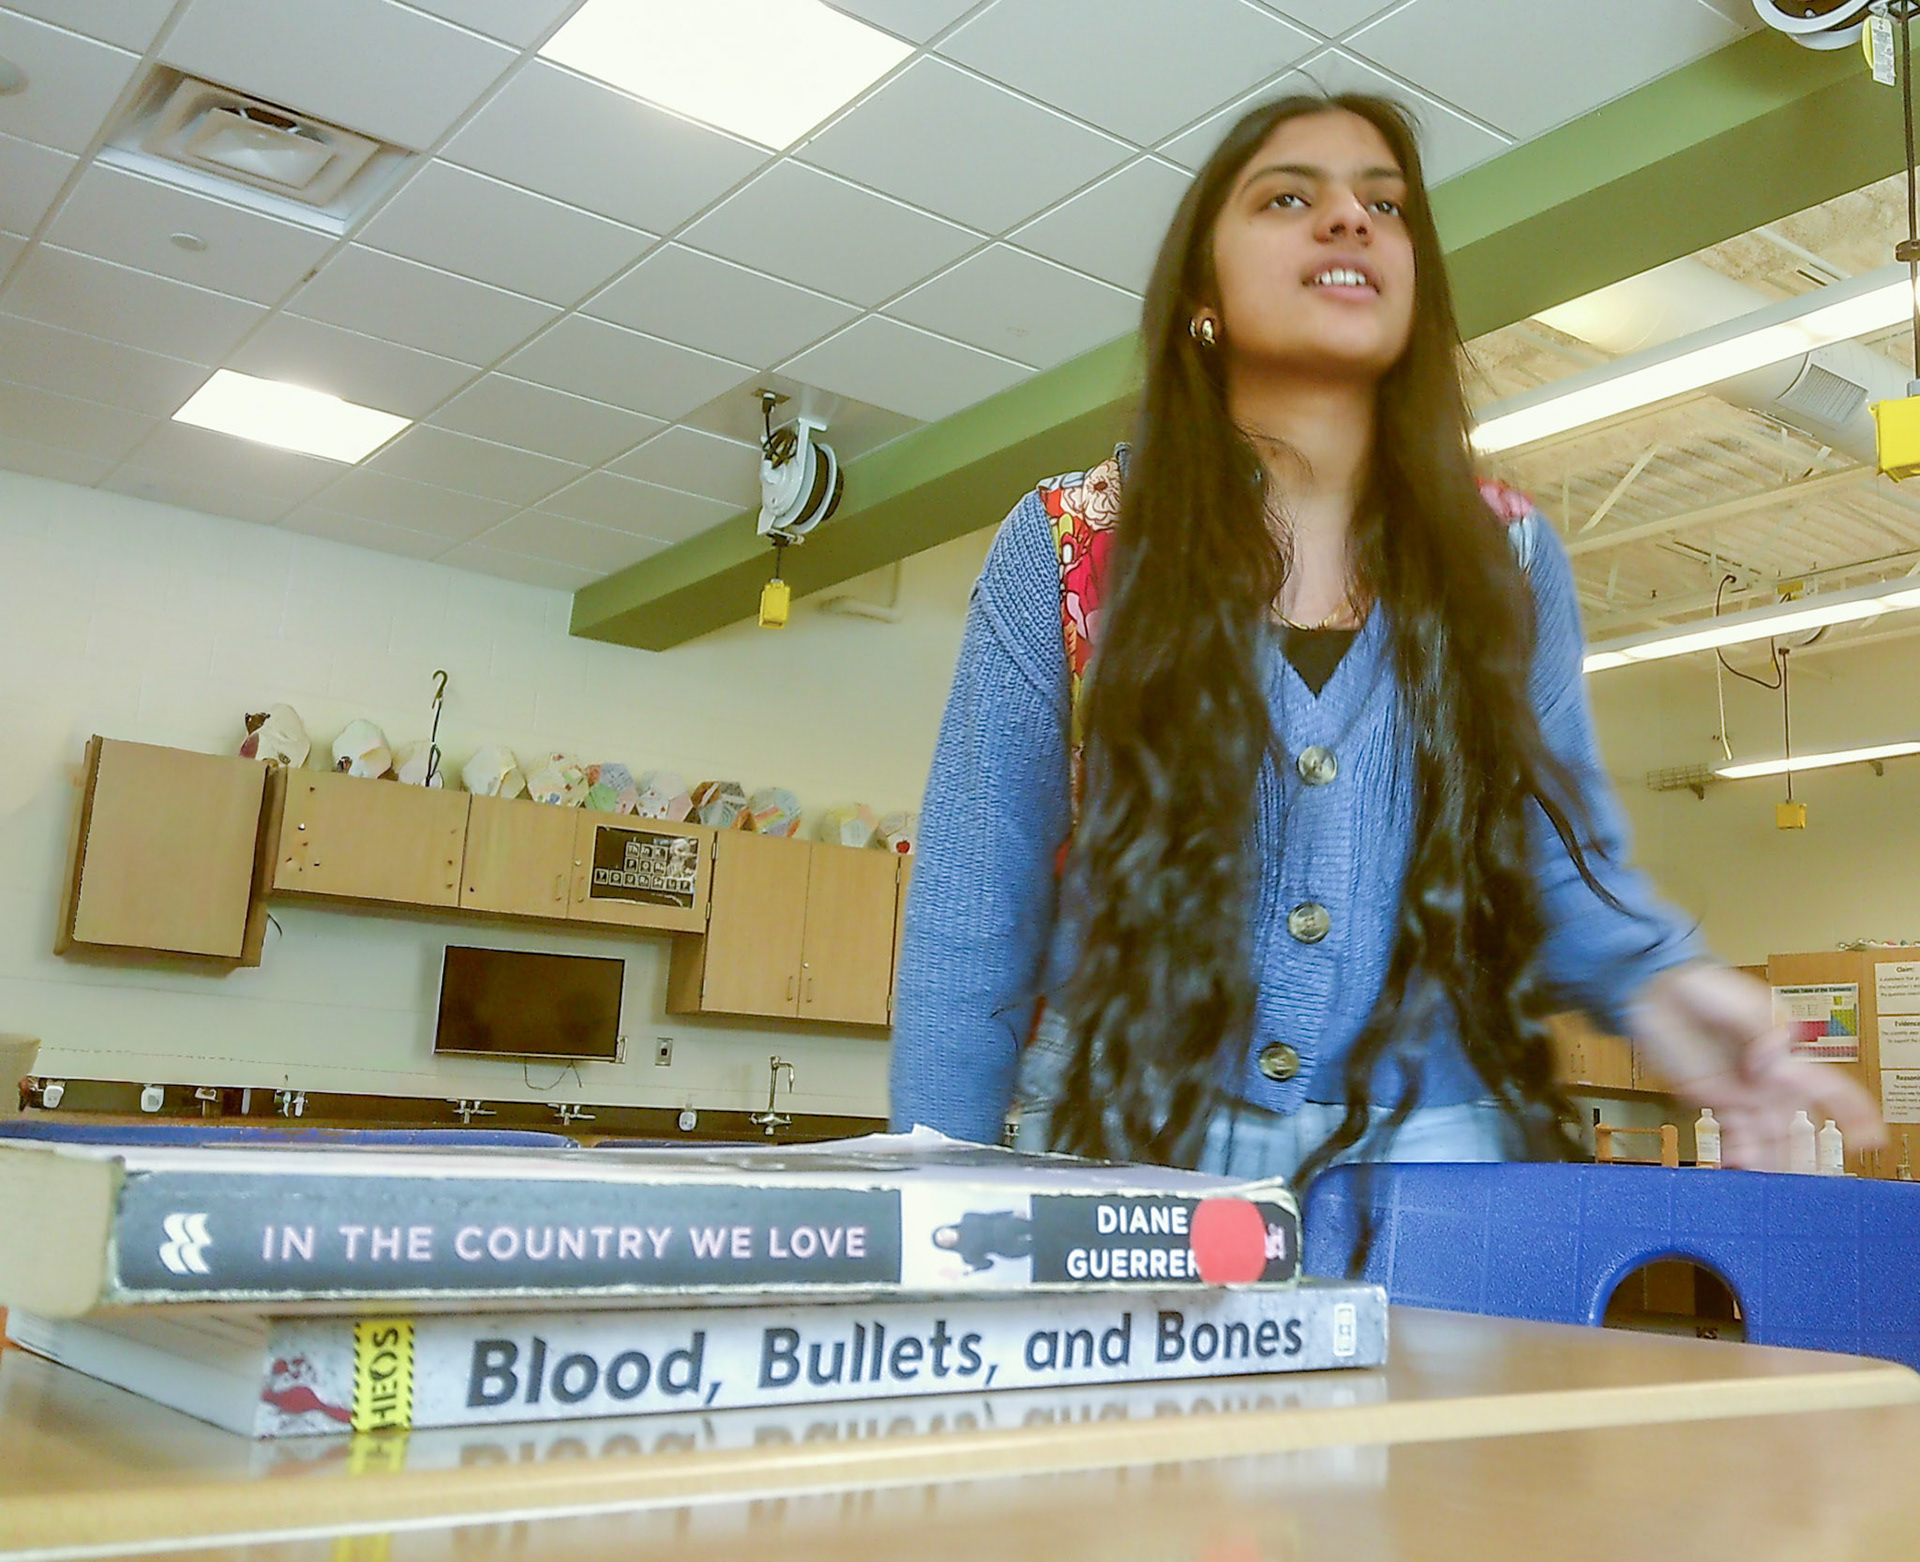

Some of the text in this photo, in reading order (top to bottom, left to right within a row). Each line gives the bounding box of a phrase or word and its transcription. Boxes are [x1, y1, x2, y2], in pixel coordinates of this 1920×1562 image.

[1096, 1205, 1189, 1235] DIANE
[261, 1226, 867, 1261] IN THE COUNTRY WE LOVE
[466, 1310, 1303, 1411] Blood, Bullets, and Bones
